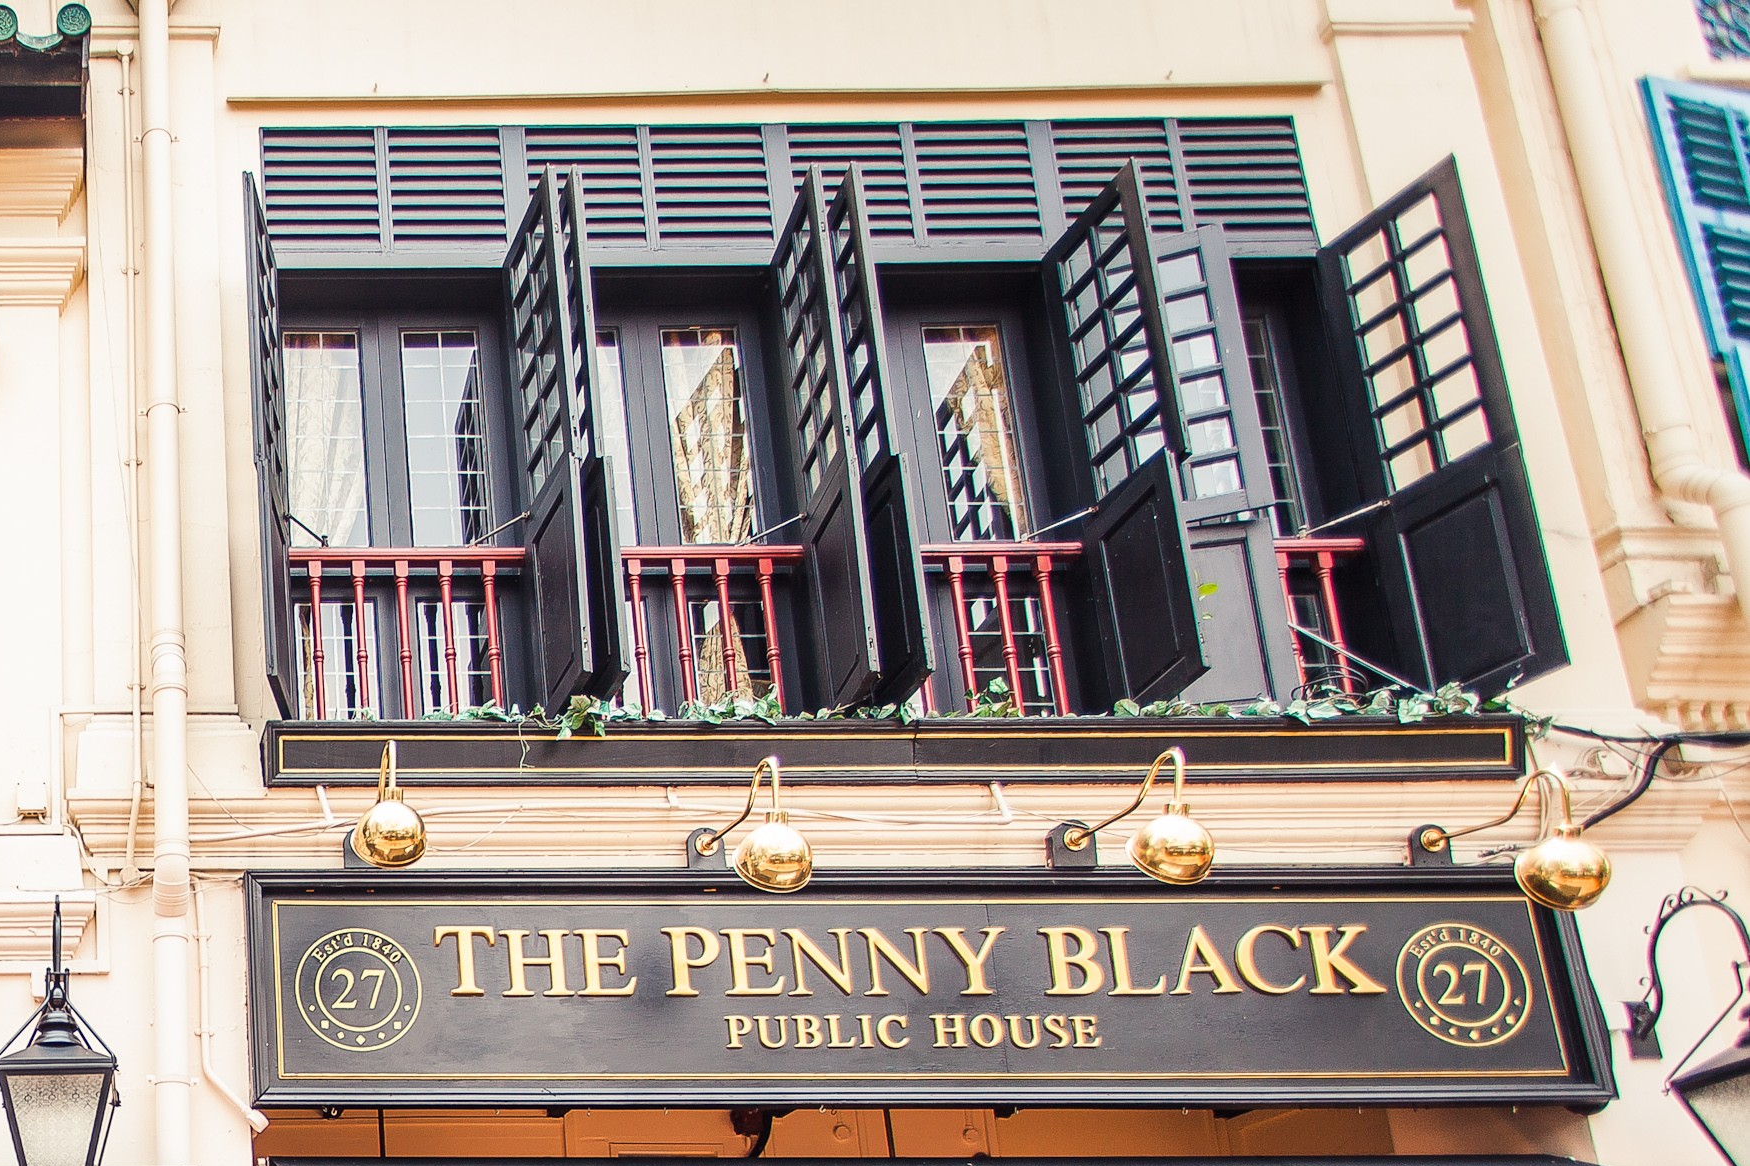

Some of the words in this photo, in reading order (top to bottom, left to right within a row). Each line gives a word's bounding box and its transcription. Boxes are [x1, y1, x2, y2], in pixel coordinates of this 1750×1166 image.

[311, 933, 354, 963] Est'd
[362, 933, 402, 963] 1840
[434, 924, 638, 1000] THE
[660, 923, 1008, 1000] PENNY
[1037, 920, 1387, 1000] BLACK
[1408, 928, 1450, 960] Est'd
[1458, 928, 1502, 957] 1840
[330, 968, 386, 1010] 27
[1432, 961, 1489, 1005] 27
[723, 1013, 911, 1050] PUBLIC
[928, 1013, 1103, 1050] HOUSE
